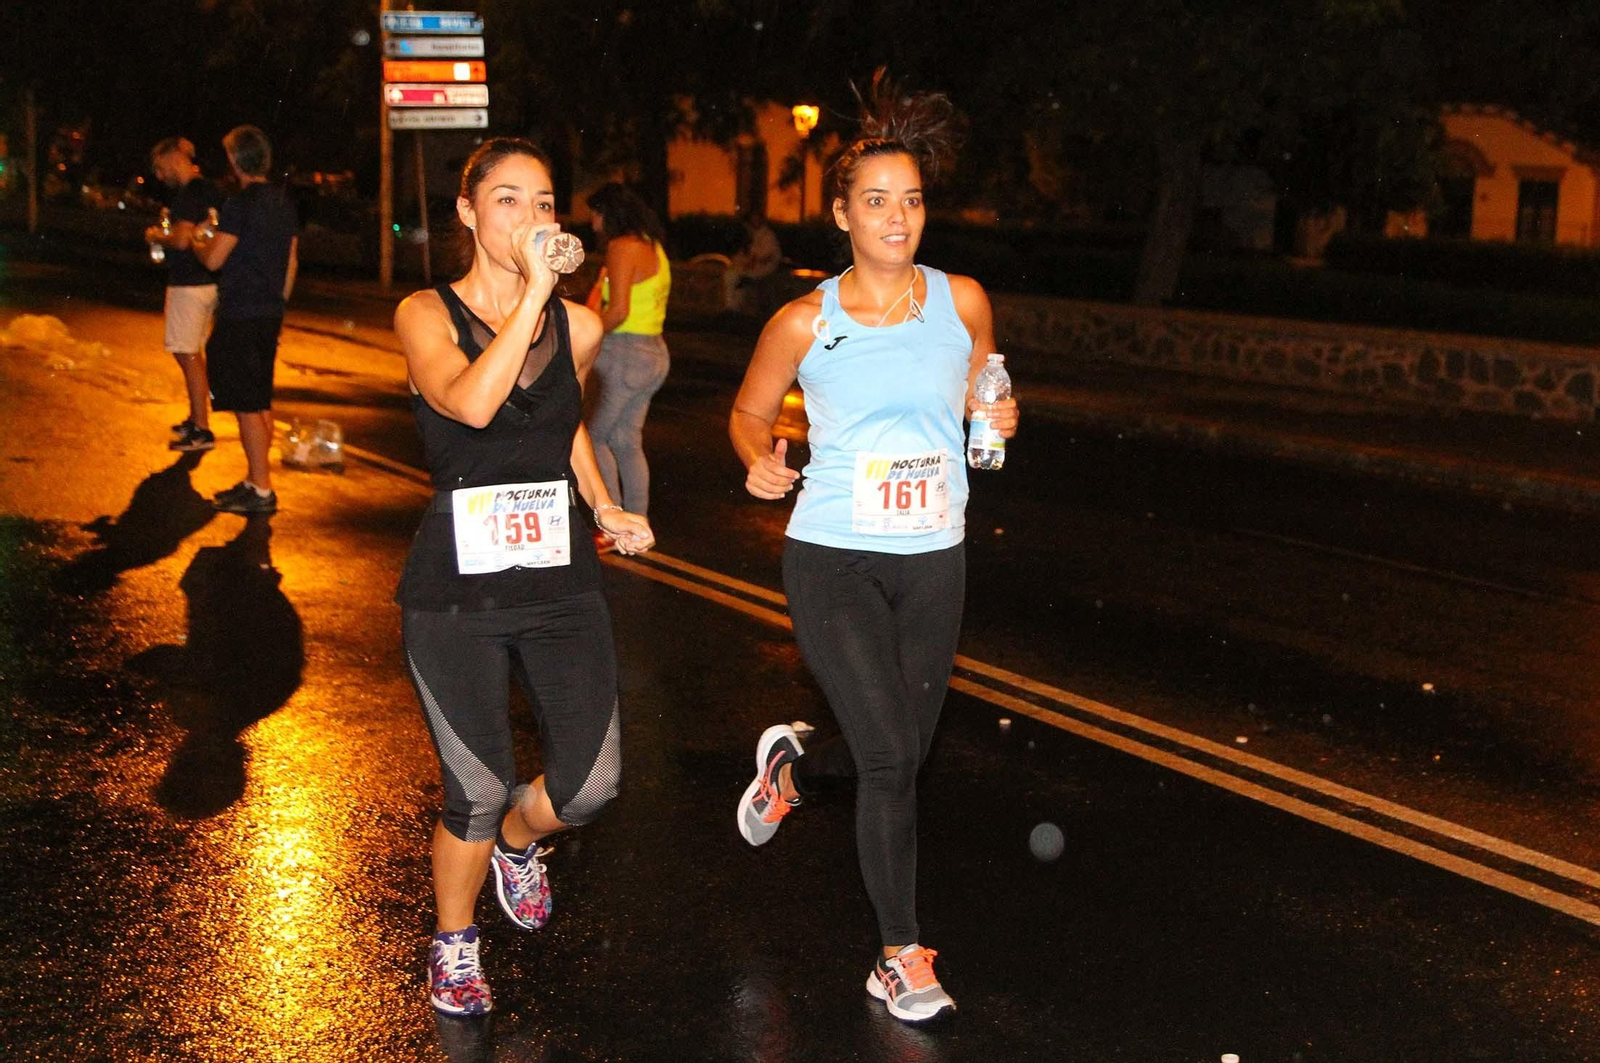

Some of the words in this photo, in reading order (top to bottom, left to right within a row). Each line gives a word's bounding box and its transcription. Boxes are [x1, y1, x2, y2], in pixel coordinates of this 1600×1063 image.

[891, 455, 941, 470] NOCTURNA
[887, 471, 903, 480] DE
[906, 466, 940, 480] HUELVA
[877, 479, 927, 510] 161
[512, 499, 555, 512] HUELVA
[483, 512, 542, 545] 159
